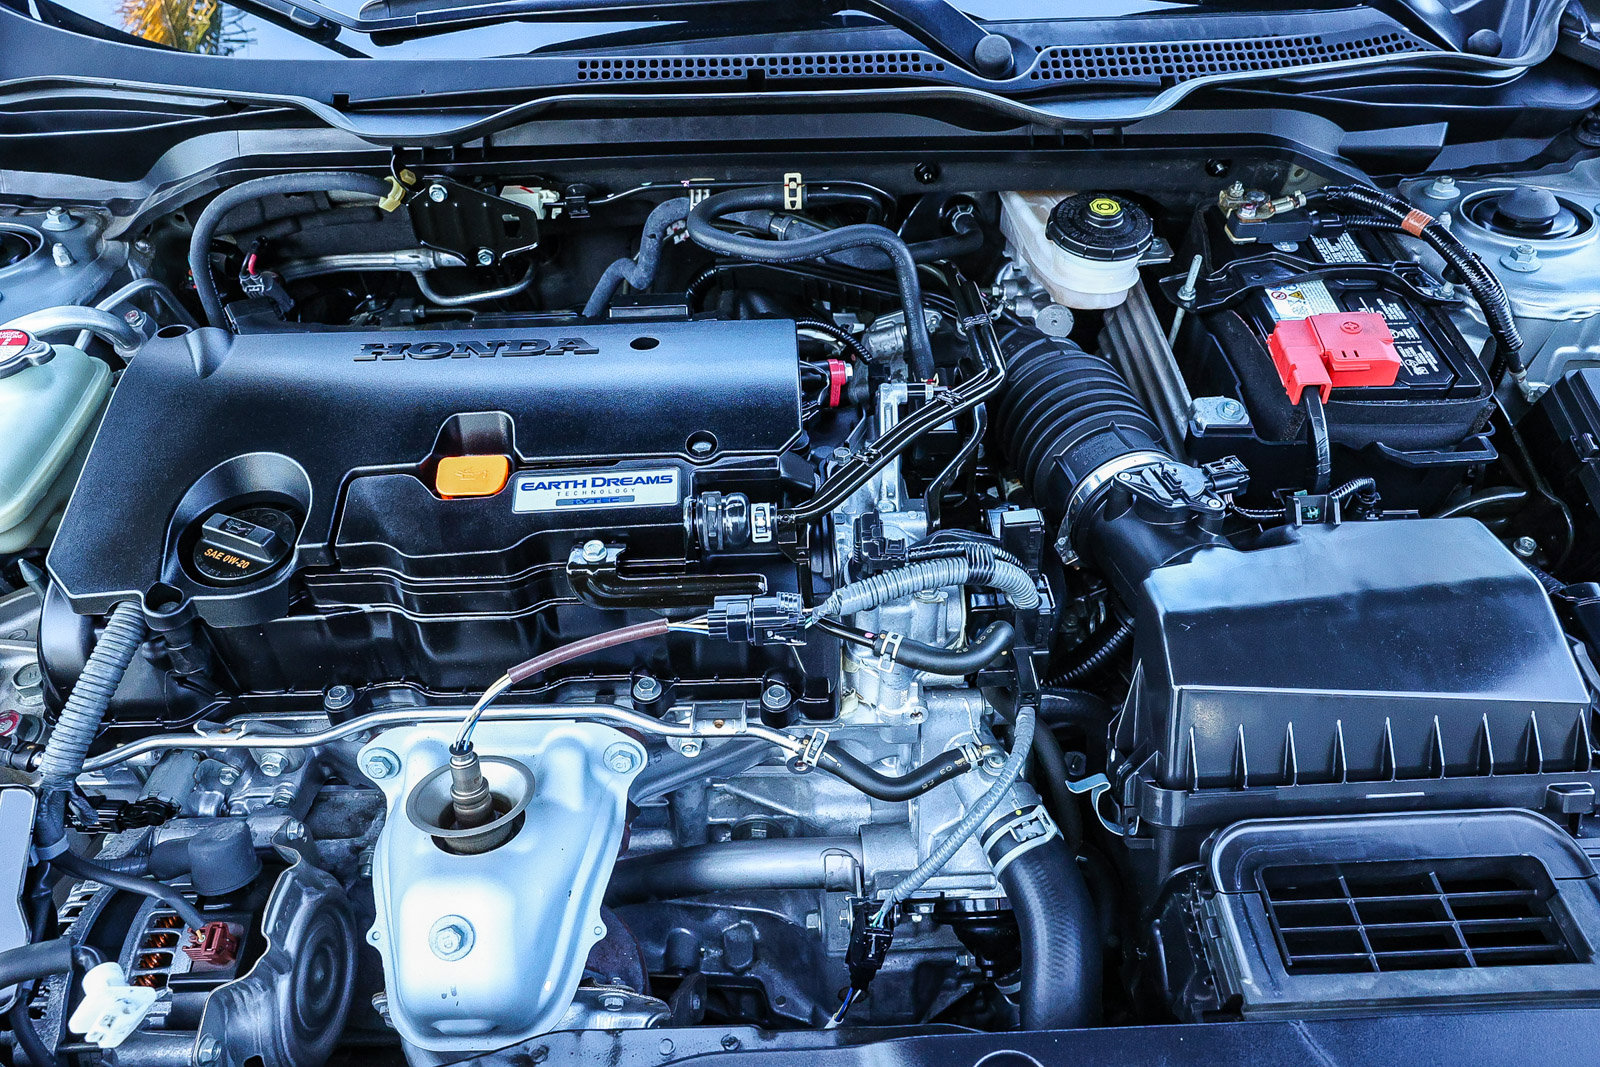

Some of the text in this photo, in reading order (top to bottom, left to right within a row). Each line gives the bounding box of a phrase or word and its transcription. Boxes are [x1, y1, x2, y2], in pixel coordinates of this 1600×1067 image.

[353, 337, 600, 362] HONDA
[521, 479, 587, 491] EARTH
[557, 487, 636, 497] TECHNOLOGY
[204, 548, 250, 569] SAE 0W-20
